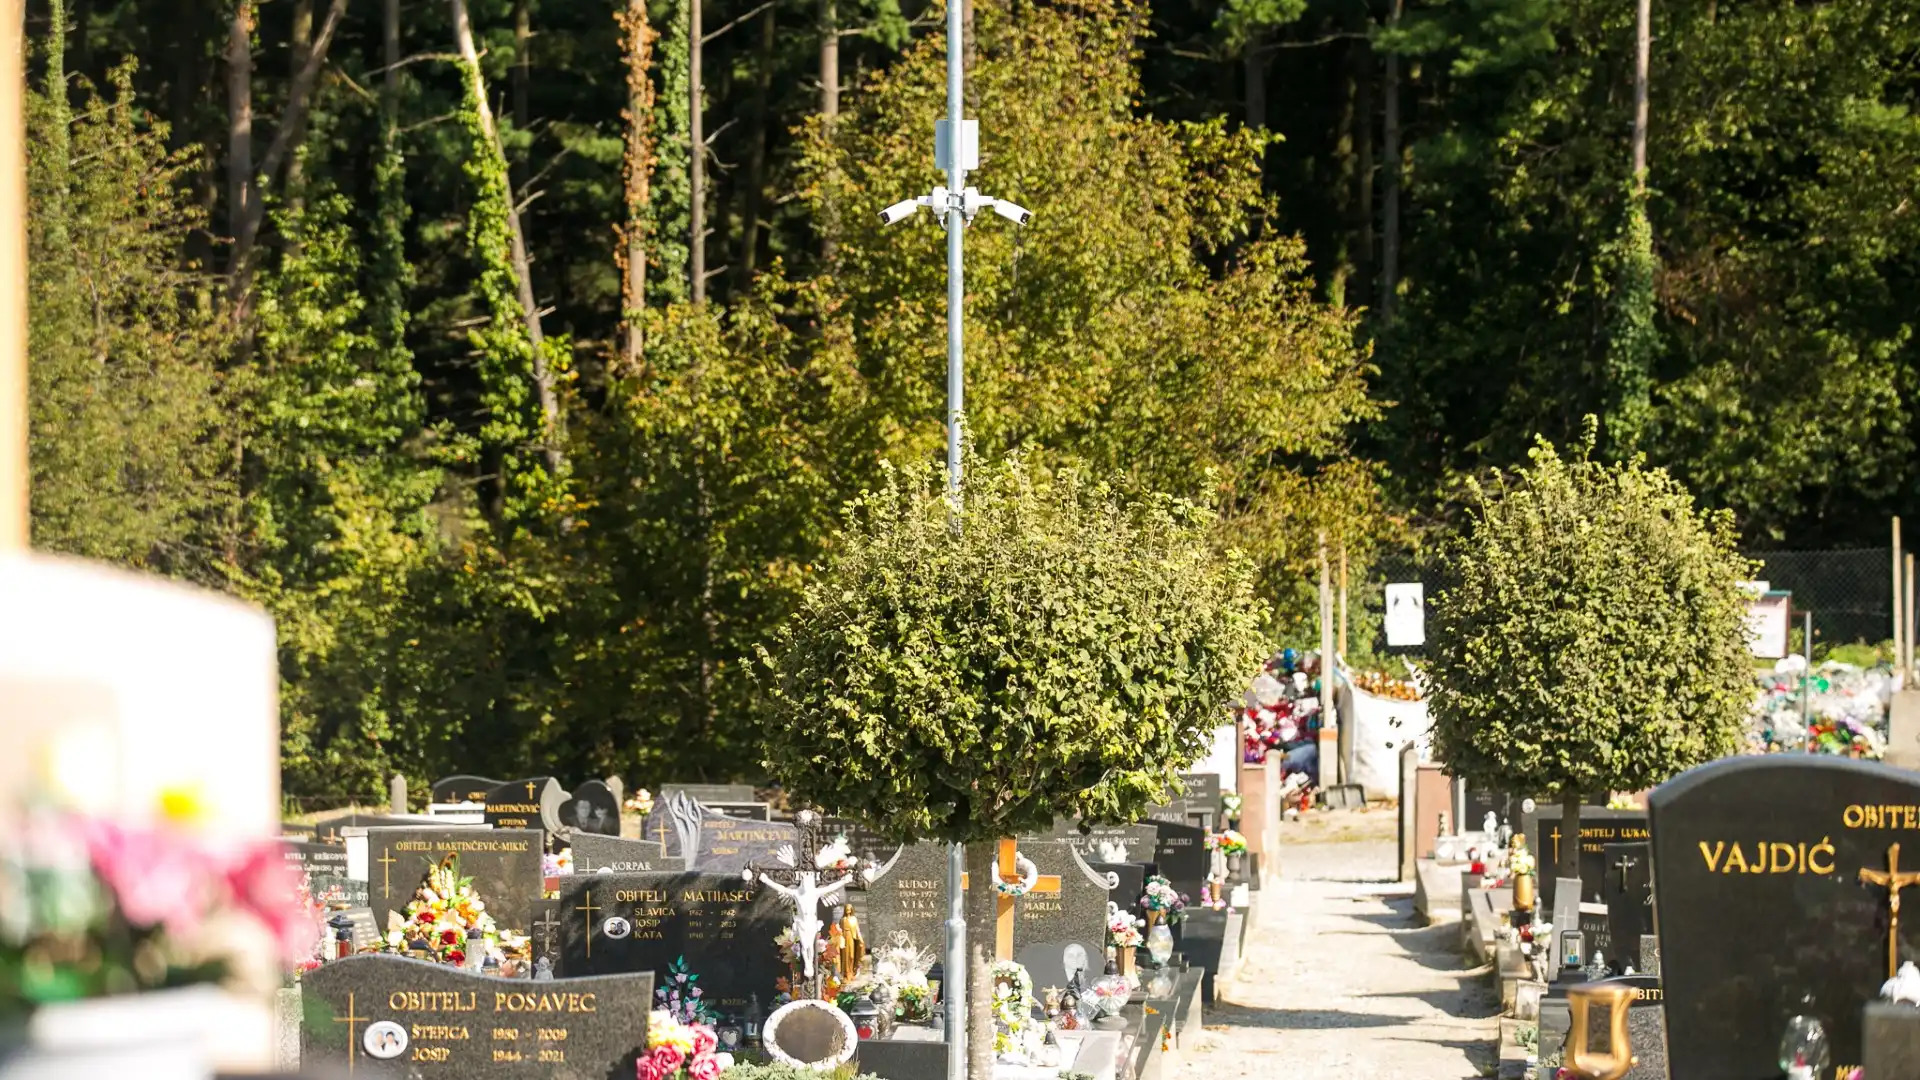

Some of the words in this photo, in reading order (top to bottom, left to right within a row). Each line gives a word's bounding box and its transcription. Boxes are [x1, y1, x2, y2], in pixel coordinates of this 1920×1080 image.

[1843, 804, 1920, 829] OBITE
[396, 841, 432, 851] OBITELJ
[1699, 835, 1836, 875] VAJDIĆ
[611, 861, 651, 871] KORPAR
[899, 879, 940, 889] RUDOLF
[616, 890, 667, 902] OBITELJ
[634, 907, 676, 917] SLAVICA
[1024, 902, 1062, 911] MARIJA
[634, 930, 663, 939] KATA
[389, 991, 477, 1012] OBITELJ
[495, 992, 596, 1012] POSAVEC
[411, 1023, 470, 1041] ŠTEFICA
[411, 1047, 450, 1061] JOSIP
